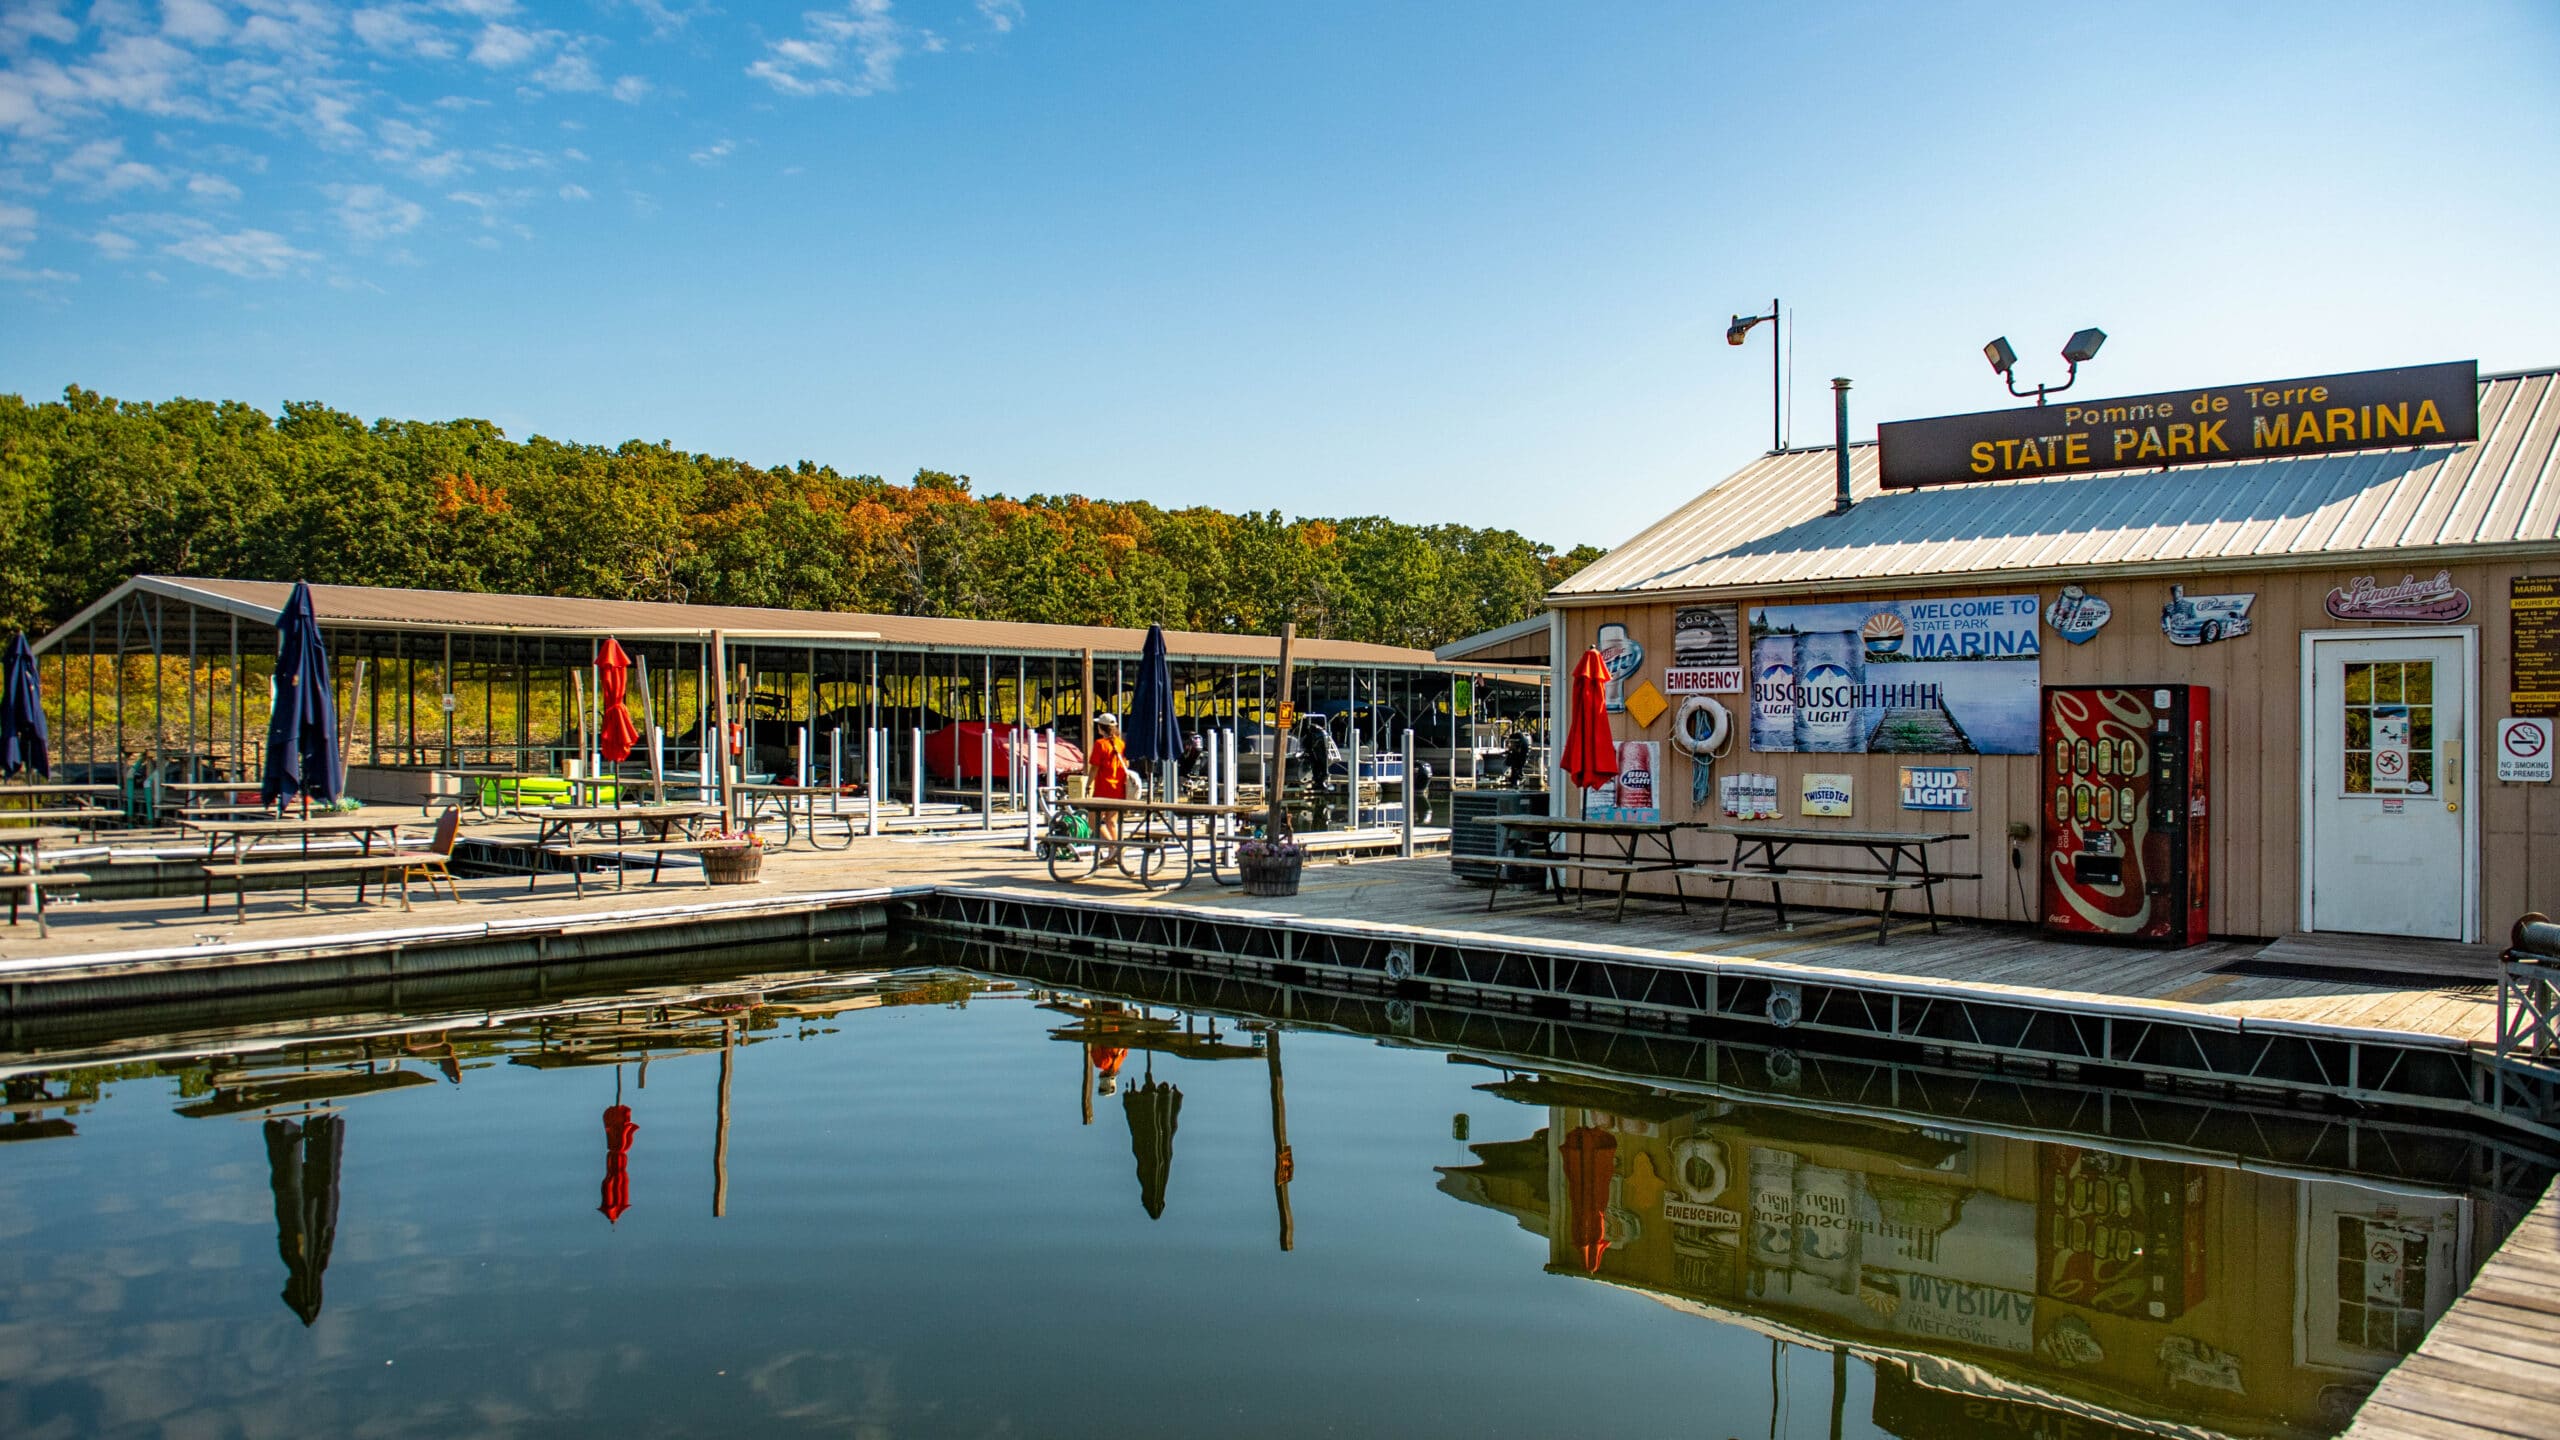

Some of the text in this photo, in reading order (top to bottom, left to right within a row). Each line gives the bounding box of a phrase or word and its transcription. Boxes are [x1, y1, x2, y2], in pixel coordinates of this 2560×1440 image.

[2065, 385, 2329, 426] Pomme de Terre
[1970, 399, 2446, 474] STATE PARK MARINA
[2514, 585, 2554, 593] MARINA
[1911, 599, 2036, 619] WELCOME TO
[1678, 615, 1716, 629] GOOSE
[1913, 618, 1989, 631] STATE PARK
[1912, 629, 2040, 658] MARINA
[1667, 671, 1740, 690] EMERGENCY
[1808, 711, 1850, 723] LIGHT
[1913, 771, 1958, 789] BUD
[1804, 790, 1849, 804] TWISTED TEA
[1903, 787, 1967, 805] LIGHT
